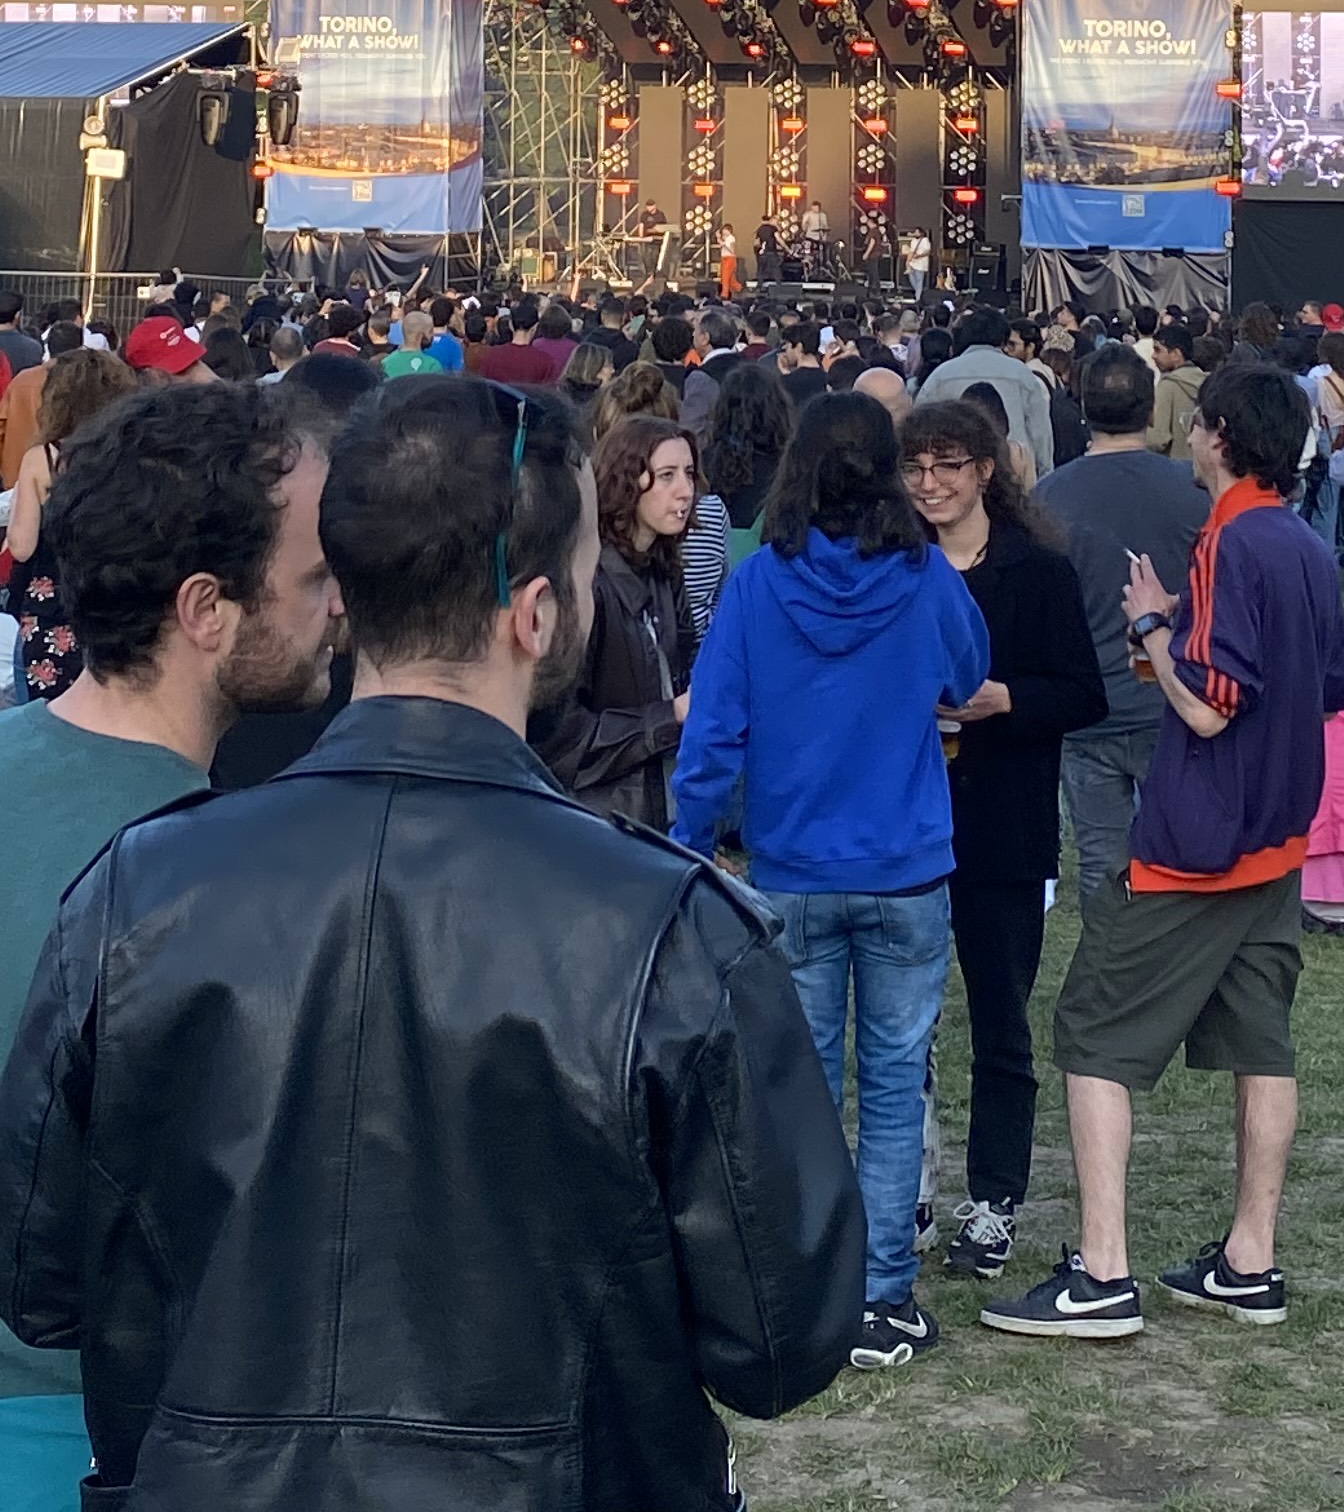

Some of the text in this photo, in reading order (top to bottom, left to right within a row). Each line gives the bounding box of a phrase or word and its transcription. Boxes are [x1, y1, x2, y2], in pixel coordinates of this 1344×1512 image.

[319, 16, 397, 36] TORINO,
[1083, 19, 1172, 40] TORINO,
[297, 35, 418, 49] WHAT A SHOW!
[1059, 39, 1196, 54] WHAT A SHOW!
